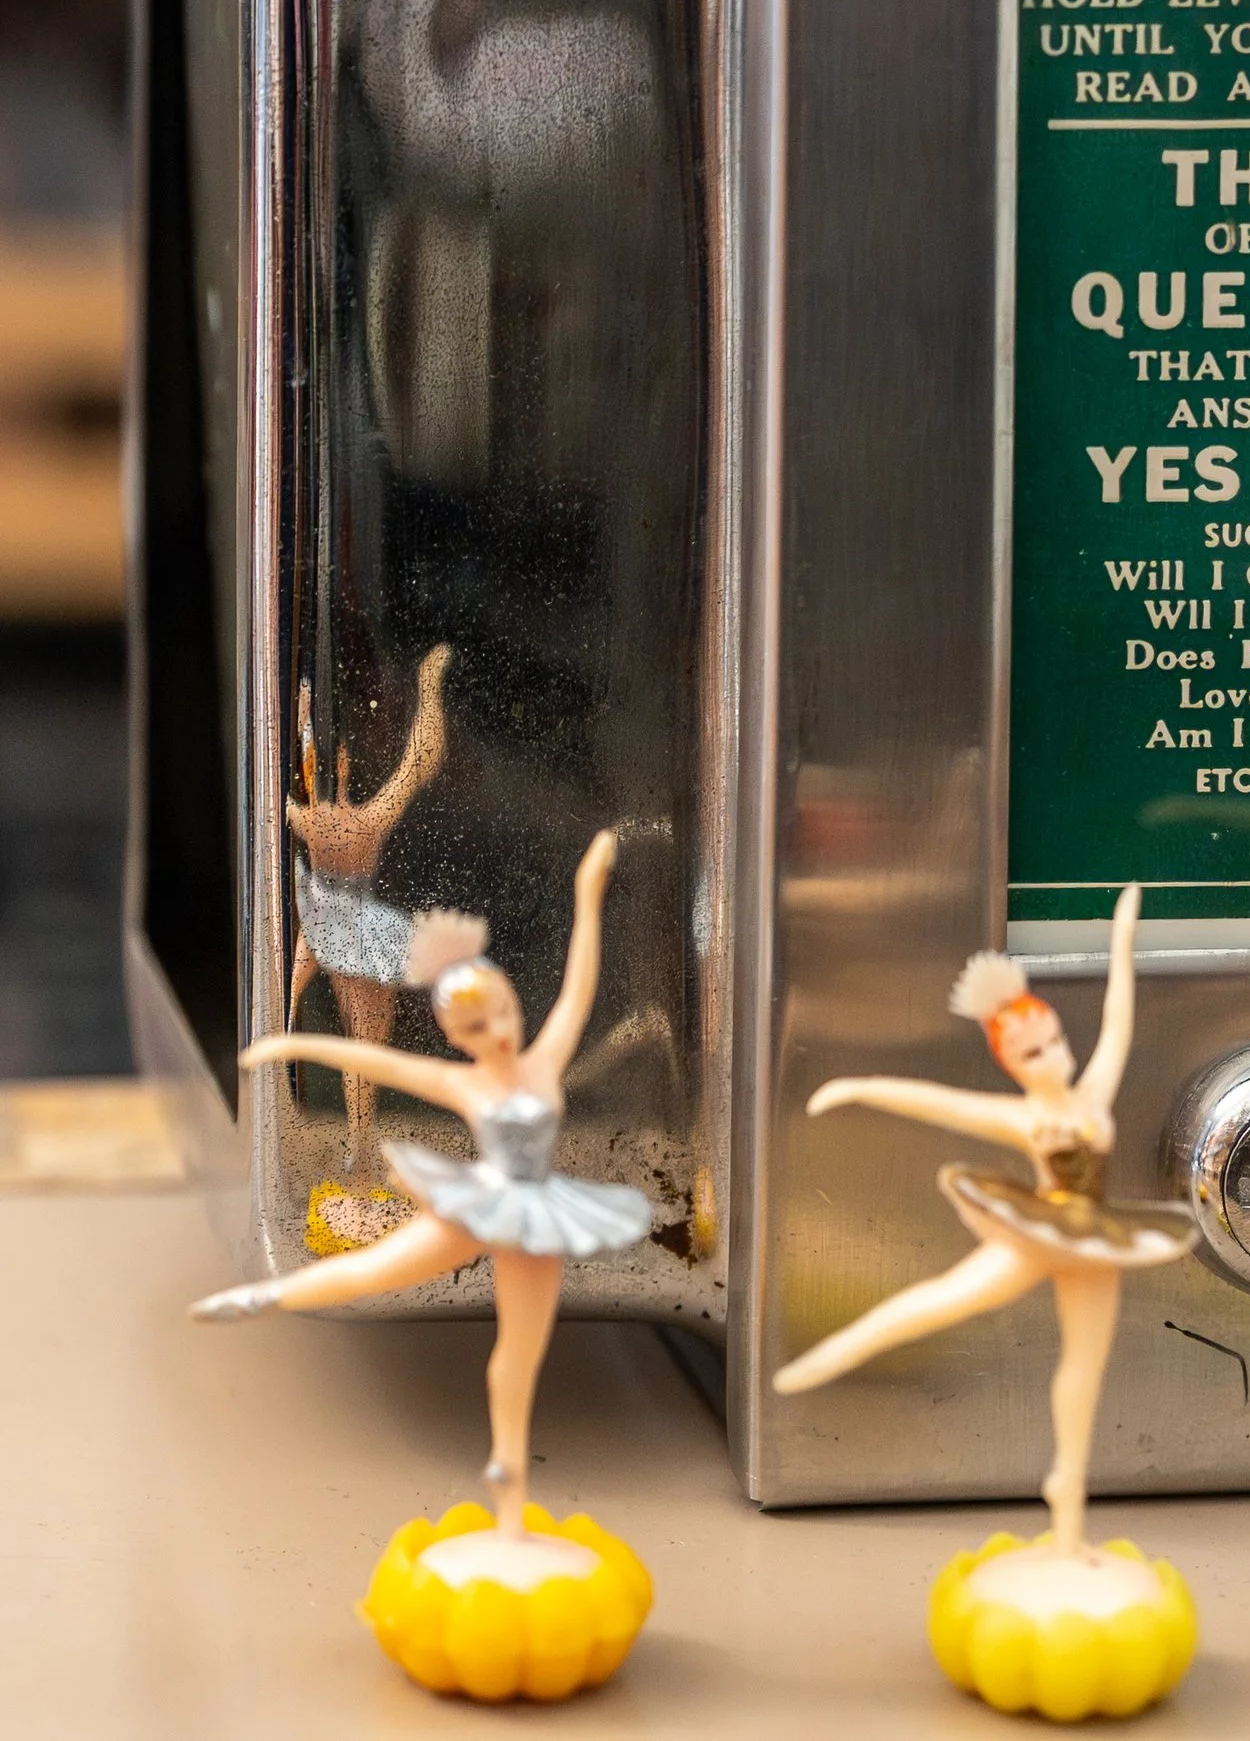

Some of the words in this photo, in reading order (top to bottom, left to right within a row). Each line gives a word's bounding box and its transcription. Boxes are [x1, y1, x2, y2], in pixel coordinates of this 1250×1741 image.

[1042, 24, 1174, 55] UNTIL
[1076, 72, 1197, 102] READ
[1087, 446, 1240, 502] YES
[1105, 560, 1183, 590] Will
[1212, 561, 1223, 590] I
[1234, 600, 1244, 628] I
[1126, 640, 1215, 669] Does
[1146, 720, 1212, 748] Am
[1233, 718, 1244, 747] I
